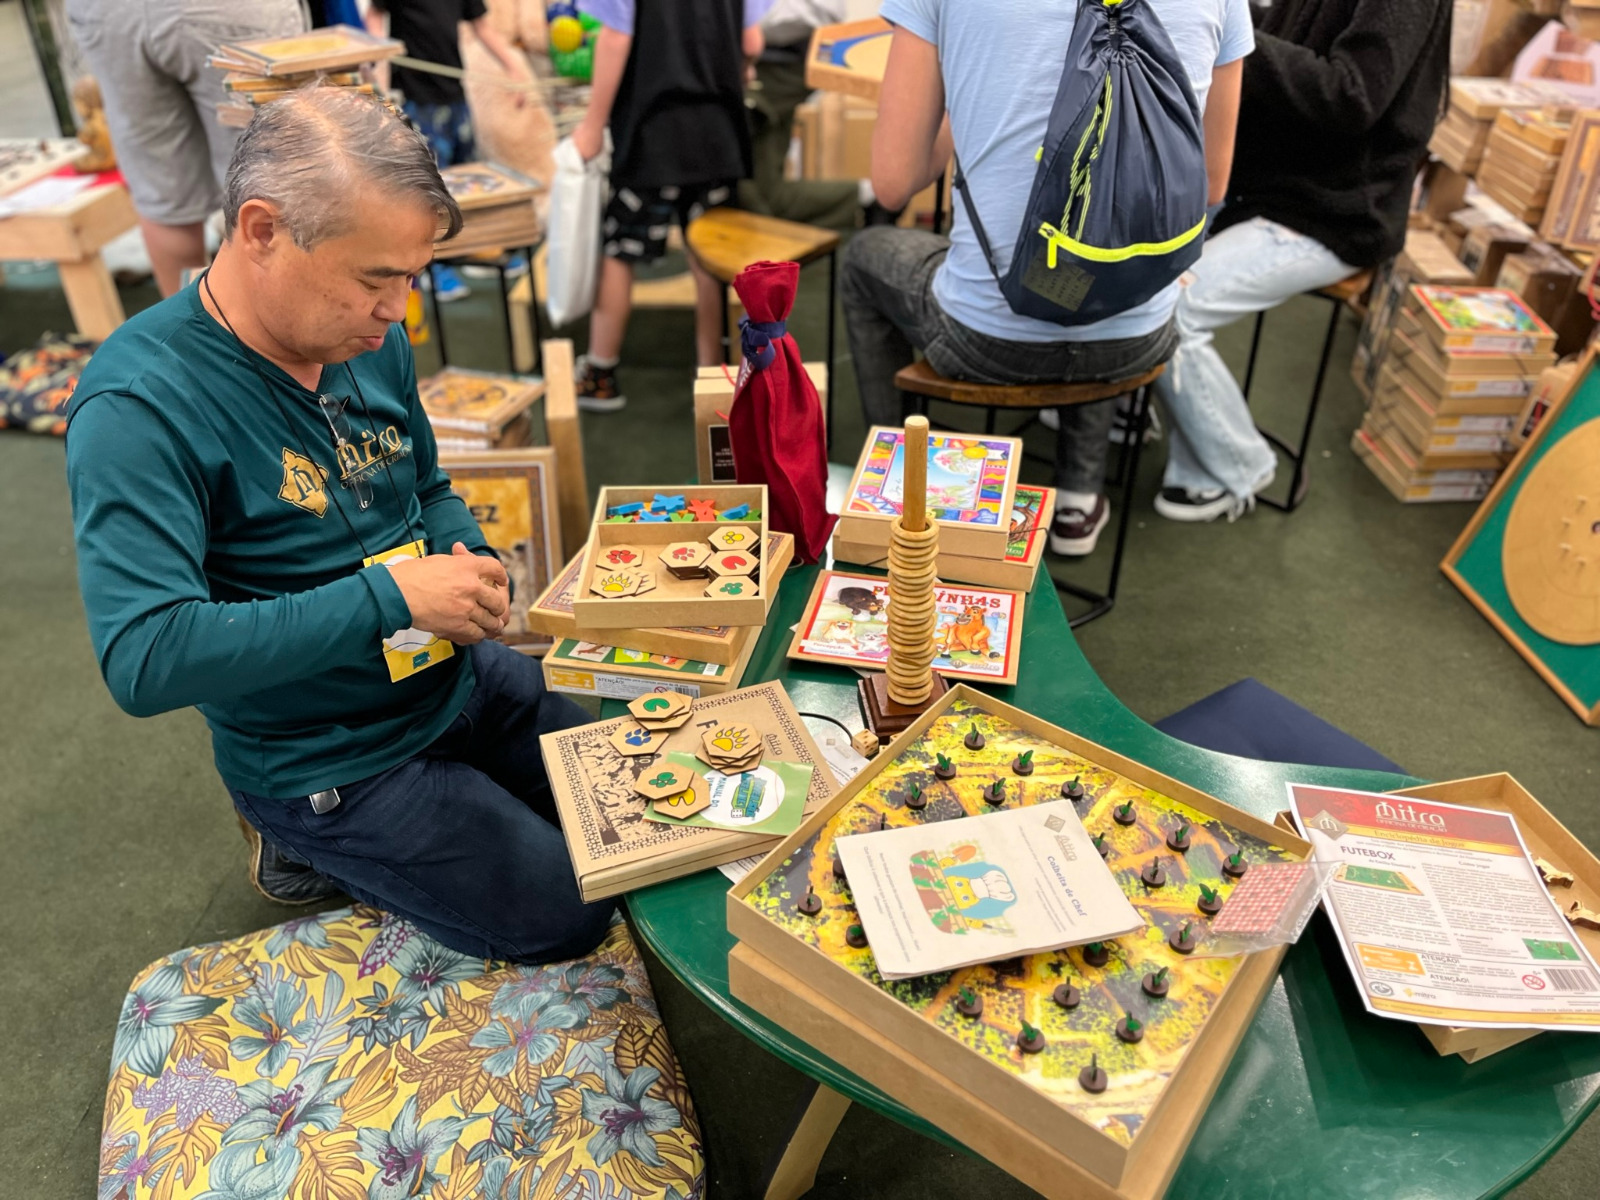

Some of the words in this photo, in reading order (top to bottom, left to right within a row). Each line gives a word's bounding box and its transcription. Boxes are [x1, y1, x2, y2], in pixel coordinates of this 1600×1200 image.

[1340, 845, 1396, 860] FUTEBOX
[1047, 855, 1068, 887] Colheita
[1071, 898, 1088, 917] Chef
